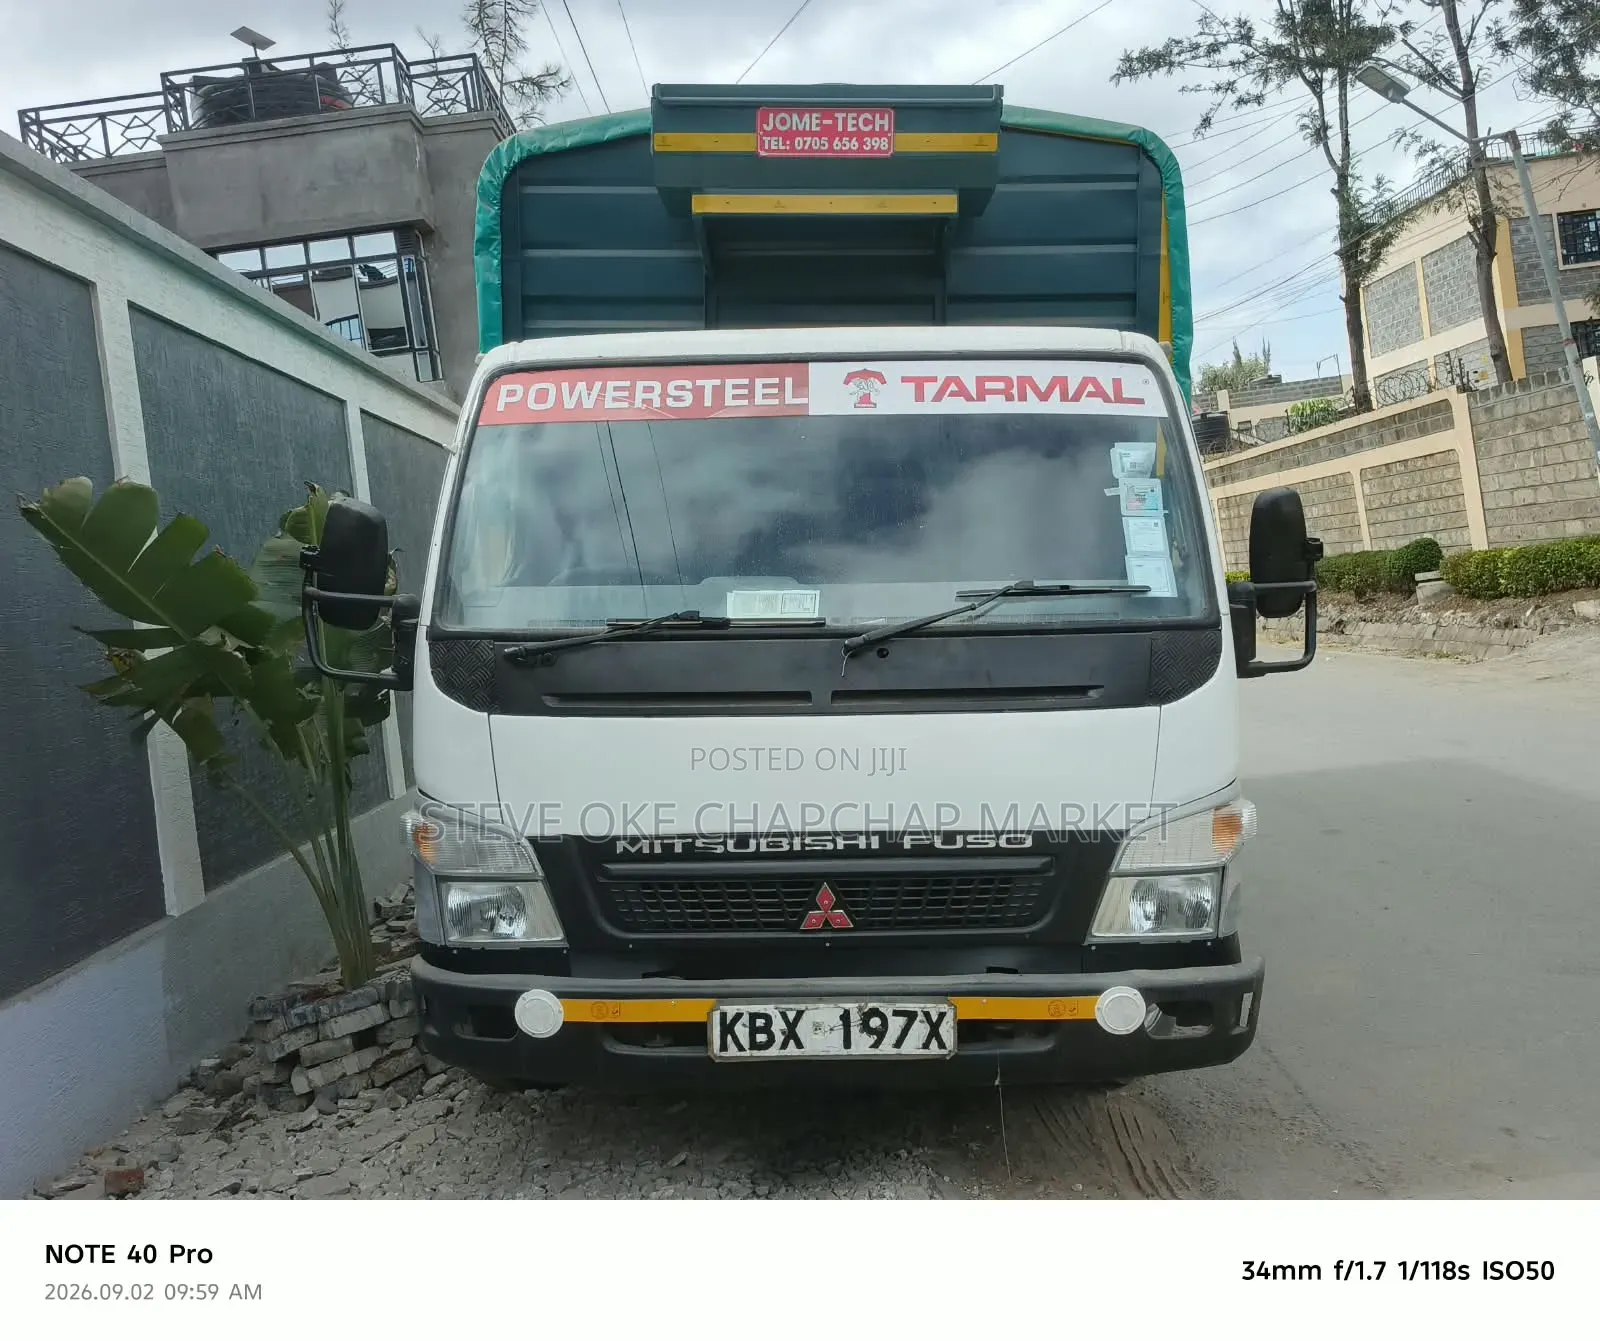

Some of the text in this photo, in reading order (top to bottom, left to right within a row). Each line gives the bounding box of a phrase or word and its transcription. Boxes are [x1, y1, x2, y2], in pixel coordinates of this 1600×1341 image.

[762, 112, 889, 132] JOME-TECH
[762, 136, 889, 151] TEL: 0705 656 398
[496, 376, 809, 412] POWERSTEEL
[900, 375, 1146, 405] TARMAL
[616, 833, 1034, 855] MITSUBISHI FUSO
[719, 1007, 948, 1053] KBX 197X
